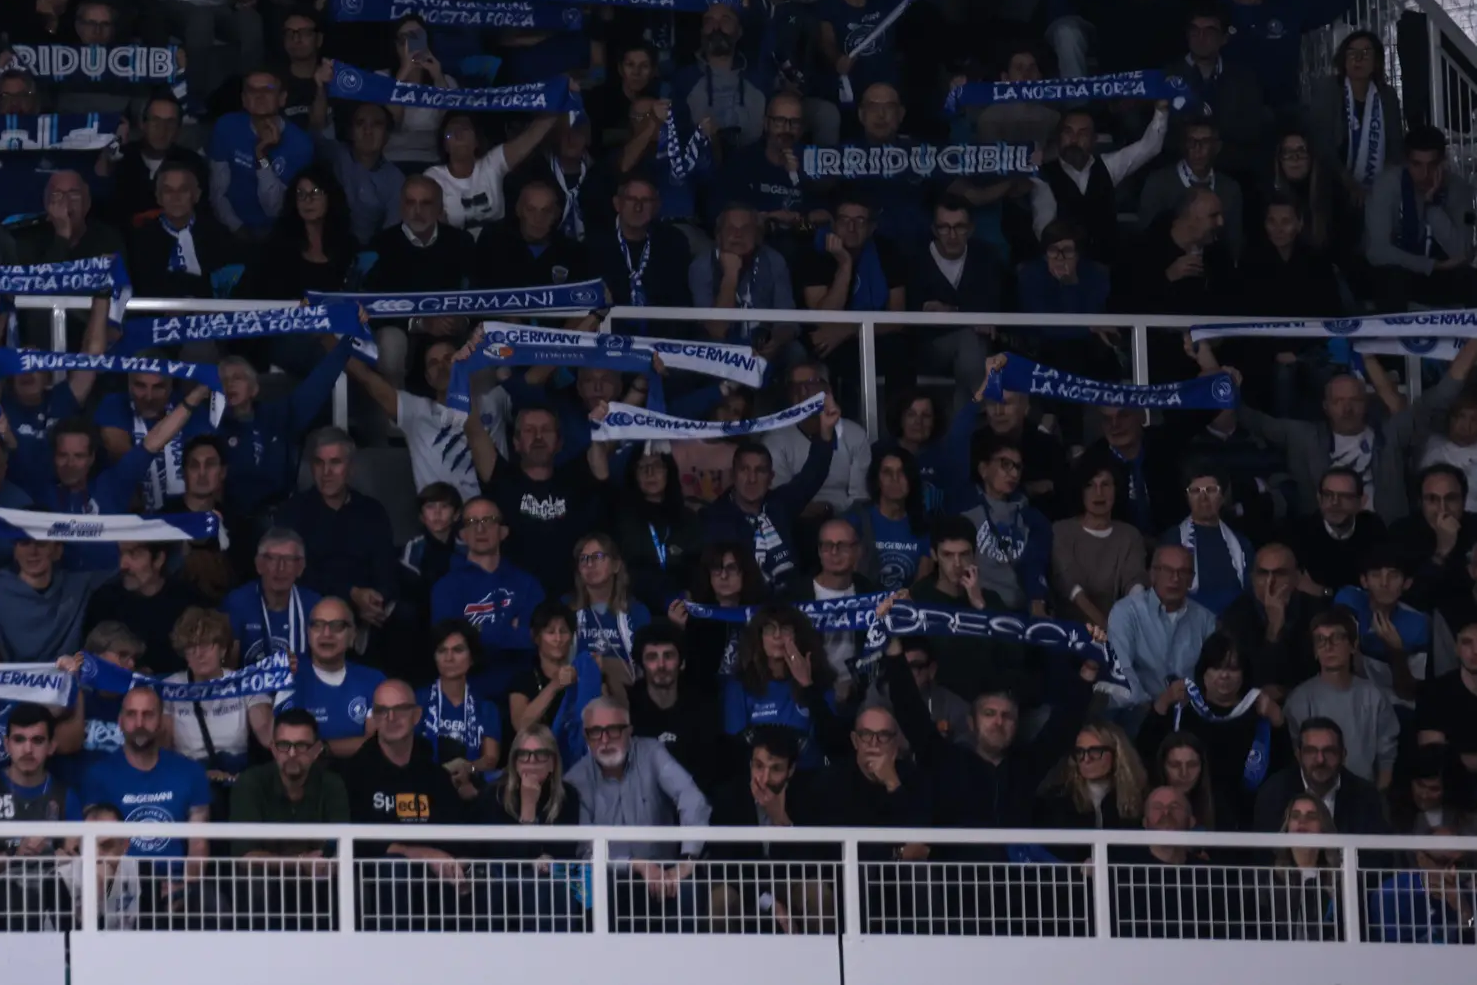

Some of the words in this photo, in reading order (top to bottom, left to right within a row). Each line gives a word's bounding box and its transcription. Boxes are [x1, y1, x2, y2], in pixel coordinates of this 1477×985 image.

[390, 88, 417, 104] LA
[993, 85, 1018, 101] LA
[1022, 82, 1089, 100] NOSTRA
[803, 143, 1038, 178] IRRIDUCIBIL
[418, 290, 554, 311] GERMANI
[153, 316, 181, 331] LA
[1412, 313, 1477, 326] GERMA
[505, 330, 581, 345] GERMANI
[682, 344, 756, 371] GERMANI
[1030, 378, 1054, 394] LA
[1057, 381, 1126, 405] NOSTRA
